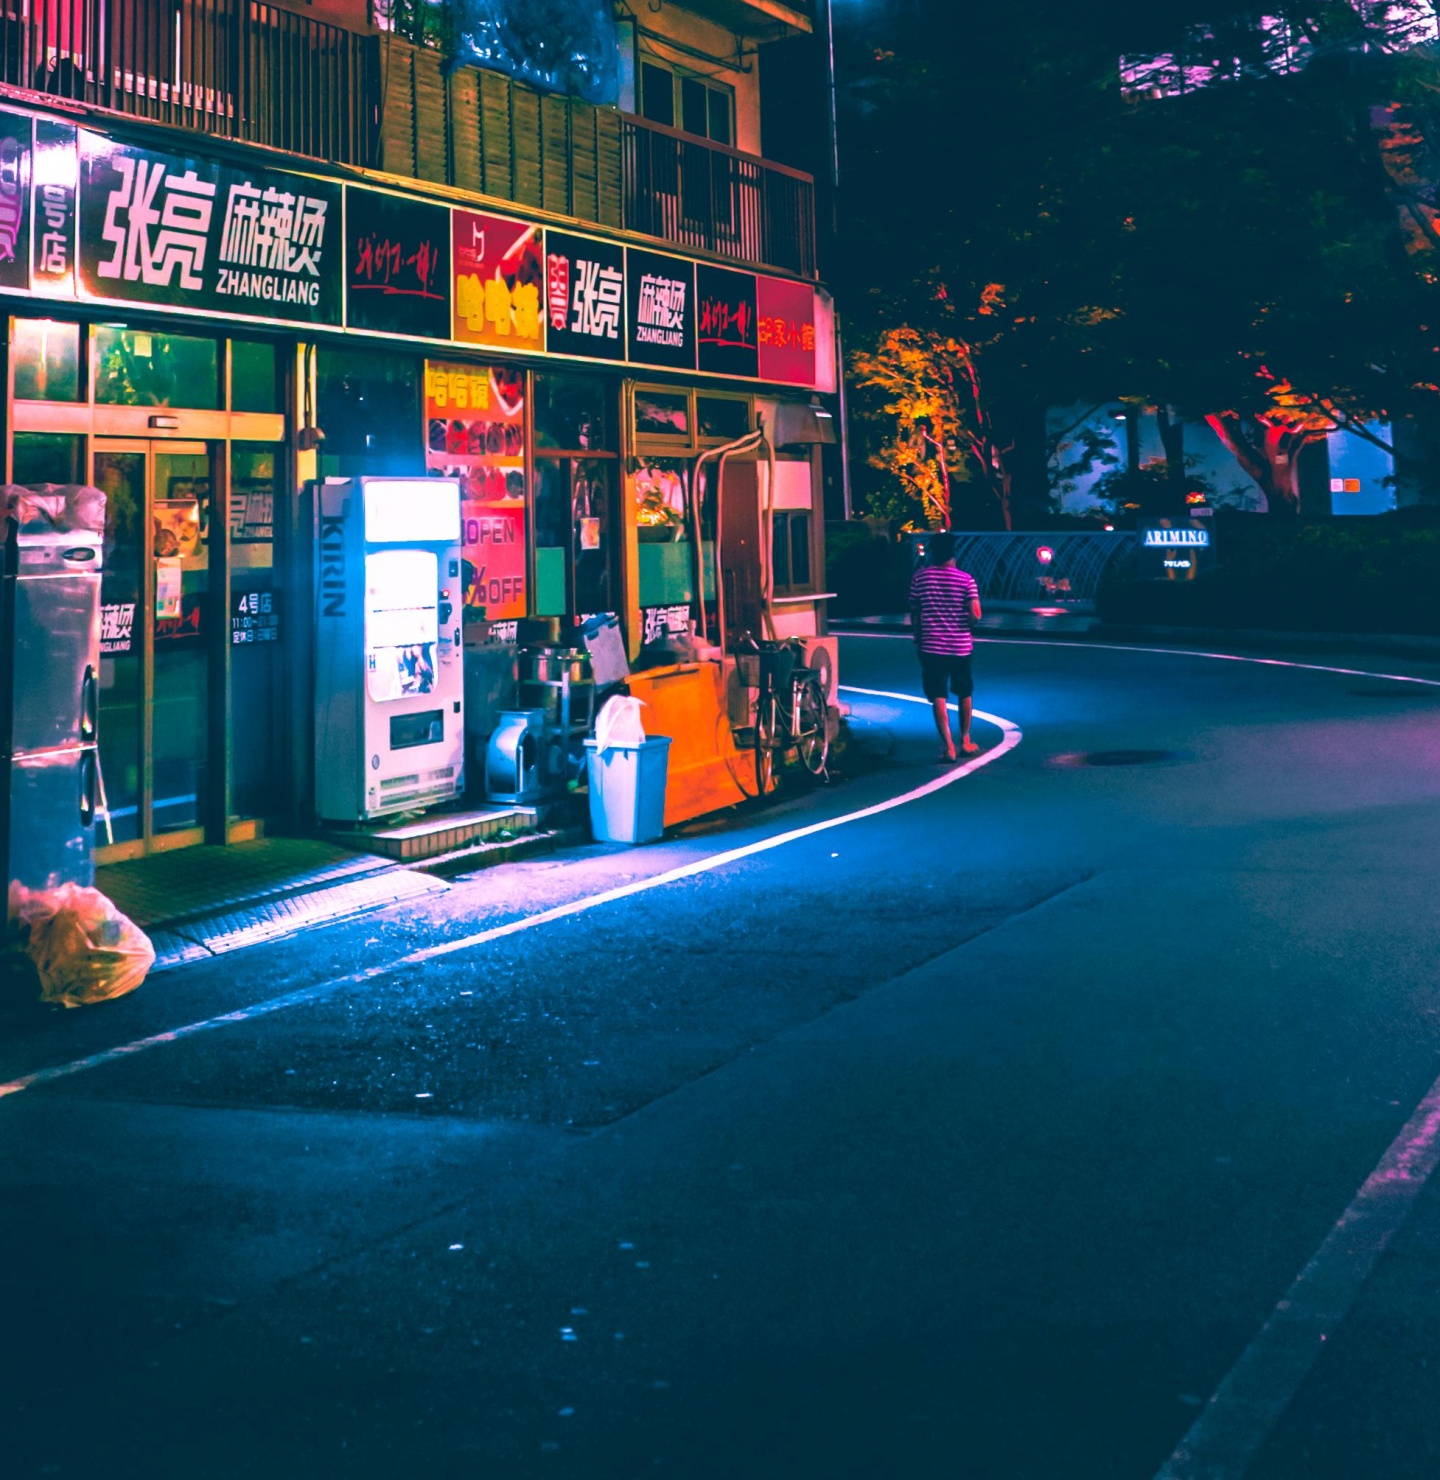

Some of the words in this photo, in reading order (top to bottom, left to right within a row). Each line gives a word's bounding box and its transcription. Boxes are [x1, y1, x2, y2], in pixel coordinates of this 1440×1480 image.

[97, 156, 216, 291] 张亮
[219, 181, 328, 277] 麻辣烫
[215, 269, 320, 306] ZHANGLIANG
[571, 259, 623, 339] 张亮
[637, 273, 687, 330] 麻辣烫
[636, 325, 683, 348] ZHANGLIANG
[466, 518, 515, 546] OPEN
[1145, 529, 1208, 545] ARIMINO
[322, 516, 346, 617] KIRIN
[461, 566, 524, 605] %OFF
[238, 592, 272, 615] 4号店
[99, 640, 131, 653] NGLIANG
